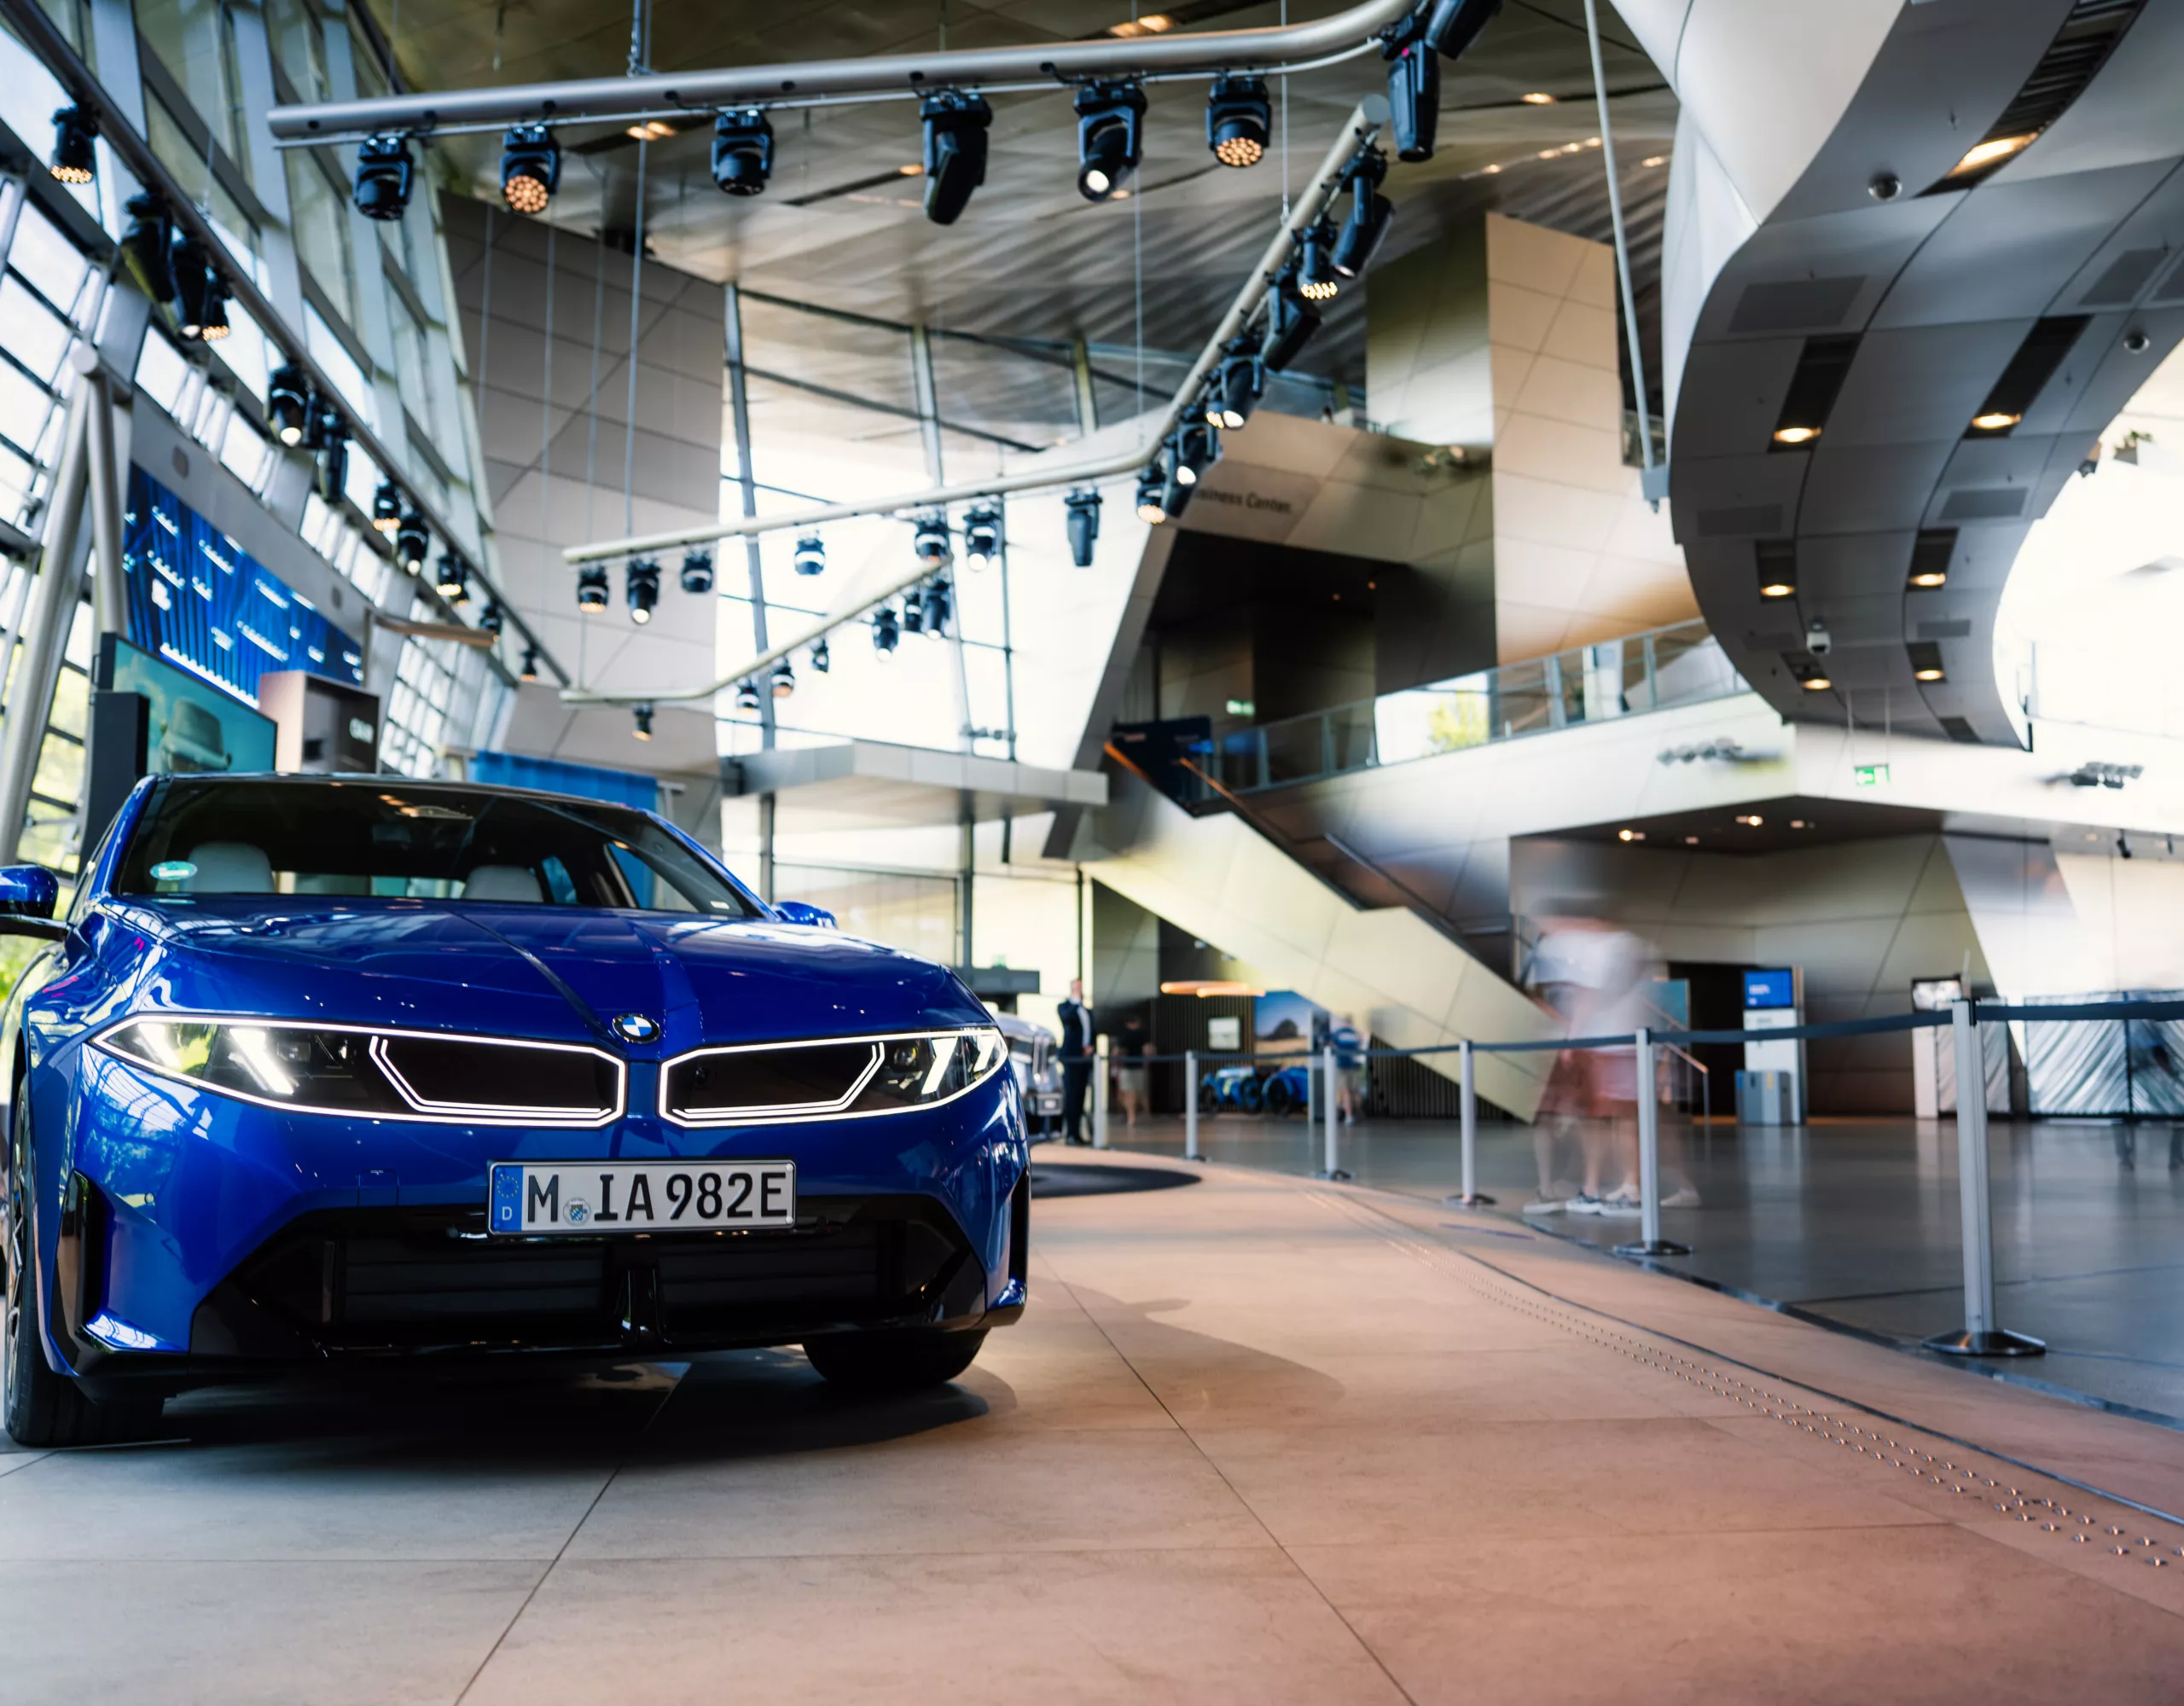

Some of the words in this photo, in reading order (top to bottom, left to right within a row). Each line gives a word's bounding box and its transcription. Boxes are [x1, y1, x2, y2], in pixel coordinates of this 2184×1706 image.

[527, 1175, 559, 1222] M
[666, 1172, 787, 1221] 982E
[502, 1206, 512, 1221] D
